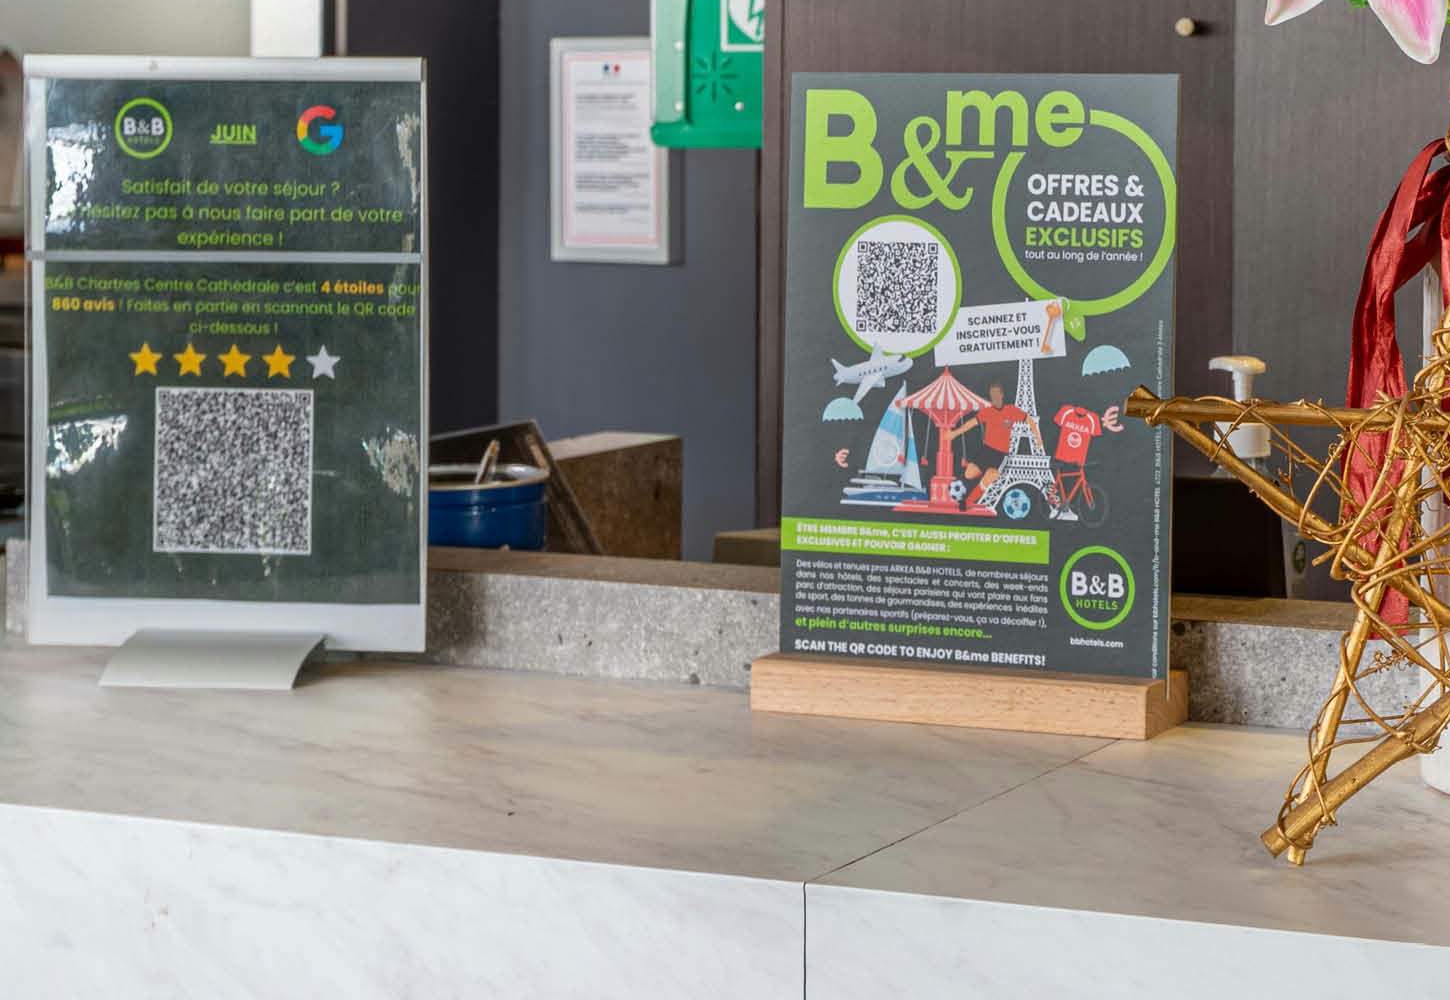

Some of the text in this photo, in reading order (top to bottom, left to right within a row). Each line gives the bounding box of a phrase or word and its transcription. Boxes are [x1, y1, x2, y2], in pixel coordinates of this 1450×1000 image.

[123, 117, 165, 136] B&B
[209, 124, 257, 143] JUIN
[122, 178, 341, 200] Satisfait de votre séjour ?
[1027, 173, 1144, 197] OFFRES &
[144, 205, 177, 221] pas
[182, 204, 194, 220] à
[198, 207, 240, 221] nous
[245, 205, 285, 221] faire
[289, 207, 325, 225] part
[331, 206, 353, 222] de
[358, 208, 403, 222] votre
[1026, 200, 1144, 223] CADEAUX
[176, 231, 273, 248] expérience
[1025, 226, 1143, 248] EXCLUSIFS
[1025, 250, 1045, 259] tout
[1047, 251, 1060, 260] au
[1062, 250, 1084, 263] long
[1086, 251, 1099, 260] de
[1101, 251, 1138, 261] l'année
[77, 276, 140, 291] Chartres
[144, 277, 193, 292] Centre
[196, 278, 280, 293] Cathédrale
[320, 280, 331, 293] 4
[333, 279, 385, 295] étoiles
[83, 297, 115, 311] avis
[126, 298, 169, 312] Faites
[173, 301, 192, 313] en
[195, 300, 238, 315] partie
[242, 302, 260, 314] en
[264, 302, 333, 315] scannant
[337, 301, 350, 315] le
[353, 302, 374, 316] QR
[377, 303, 416, 316] code
[189, 321, 270, 335] ci-dessous
[967, 312, 1027, 326] SCANNEZ ET
[956, 324, 1041, 340] INSCRIVEZ-VOUS
[958, 339, 1035, 353] GRATUITEMENT
[797, 536, 850, 547] EXCLUSIVES
[853, 538, 862, 547] ET
[864, 539, 906, 550] POUVOIR
[907, 541, 946, 552] GAGNER
[820, 524, 857, 535] MEMBRE
[892, 529, 917, 538] C'EST
[919, 530, 947, 540] AUSSI
[949, 531, 991, 542] PROFITER
[993, 533, 1037, 545] D'OFFRES
[796, 559, 811, 568] Des
[812, 560, 833, 570] vélos
[834, 561, 842, 570] et
[842, 561, 870, 571] tenues
[871, 564, 889, 574] pros
[915, 565, 931, 575] B&B
[965, 568, 976, 577] de
[977, 569, 1018, 580] nombreux
[1019, 571, 1048, 583] séjours
[796, 570, 816, 579] dans
[820, 572, 834, 580] nos
[867, 574, 881, 582] des
[885, 575, 928, 585] spectacles
[932, 578, 940, 586] et
[984, 581, 999, 590] des
[1003, 582, 1048, 593] week-ends
[1071, 571, 1125, 598] B&B
[796, 580, 814, 590] parc
[866, 584, 881, 593] des
[883, 585, 912, 596] séjours
[914, 587, 950, 598] parisiens
[952, 589, 965, 600] qui
[968, 590, 985, 599] vont
[987, 590, 1011, 601] plaire
[1013, 593, 1028, 601] aux
[1030, 593, 1048, 604] fans
[795, 591, 805, 600] de
[831, 593, 845, 602] des
[847, 594, 873, 603] tonnes
[875, 595, 886, 604] de
[947, 599, 962, 609] des
[964, 600, 1013, 612] expériences
[1015, 603, 1048, 614] inédites
[1075, 599, 1119, 611] HOTELS
[795, 605, 815, 613] avec
[817, 606, 831, 614] nos
[832, 606, 879, 617] partenaires
[880, 608, 909, 619] sportifs
[976, 615, 987, 625] ça
[989, 616, 999, 624] va
[1001, 616, 1037, 627] décoiffer
[795, 617, 807, 627] et
[808, 617, 836, 631] plein
[838, 618, 886, 632] d'autres
[888, 622, 941, 636] surprises
[1069, 637, 1124, 648] bbhotels.com
[794, 639, 1046, 666] SCAN THE QR CODE TO ENJOY B&me BENEFITS!
